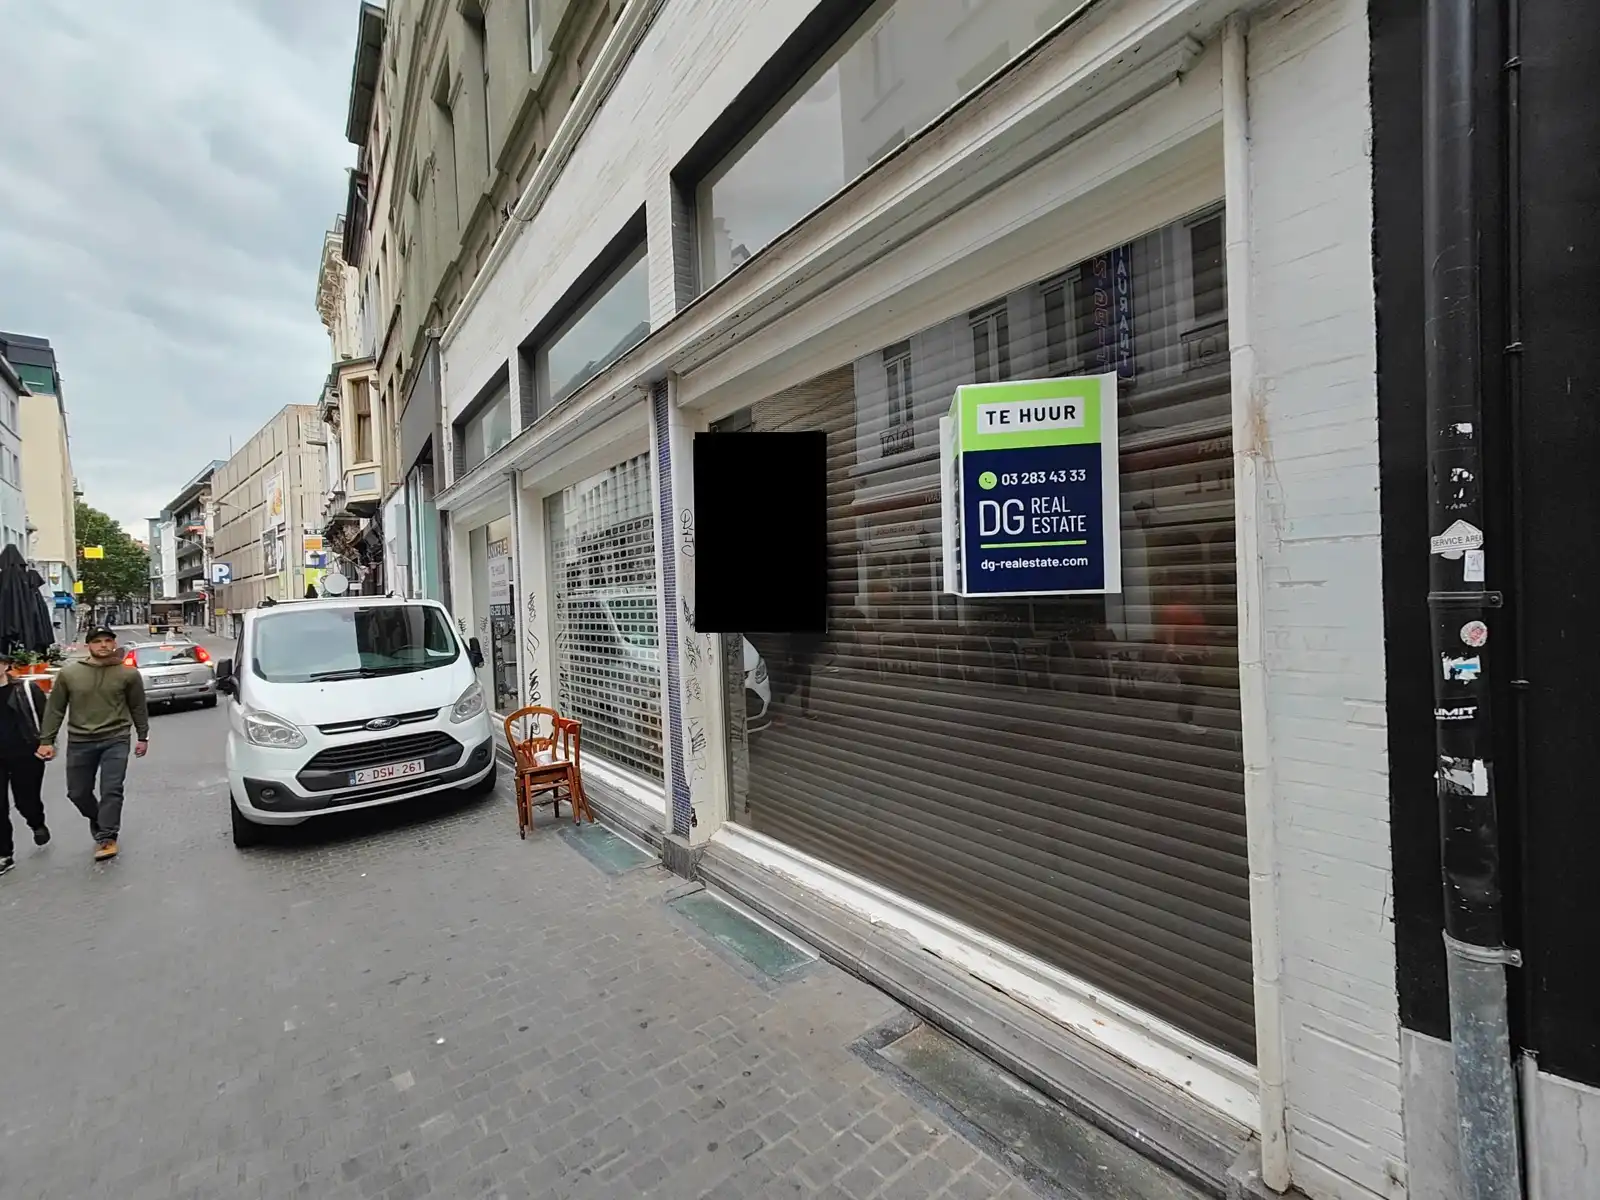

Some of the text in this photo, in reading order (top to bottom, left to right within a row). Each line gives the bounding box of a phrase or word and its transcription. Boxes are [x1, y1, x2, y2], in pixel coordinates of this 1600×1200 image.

[985, 405, 1076, 425] TE HUUR
[1001, 469, 1086, 486] 03 283 43 33
[1031, 496, 1071, 514] REAL
[979, 499, 1025, 536] DG
[1032, 515, 1087, 534] ESTATE
[1432, 533, 1482, 547] SERVICE AREA
[212, 564, 229, 582] P
[981, 558, 1088, 572] dg-realestate.com
